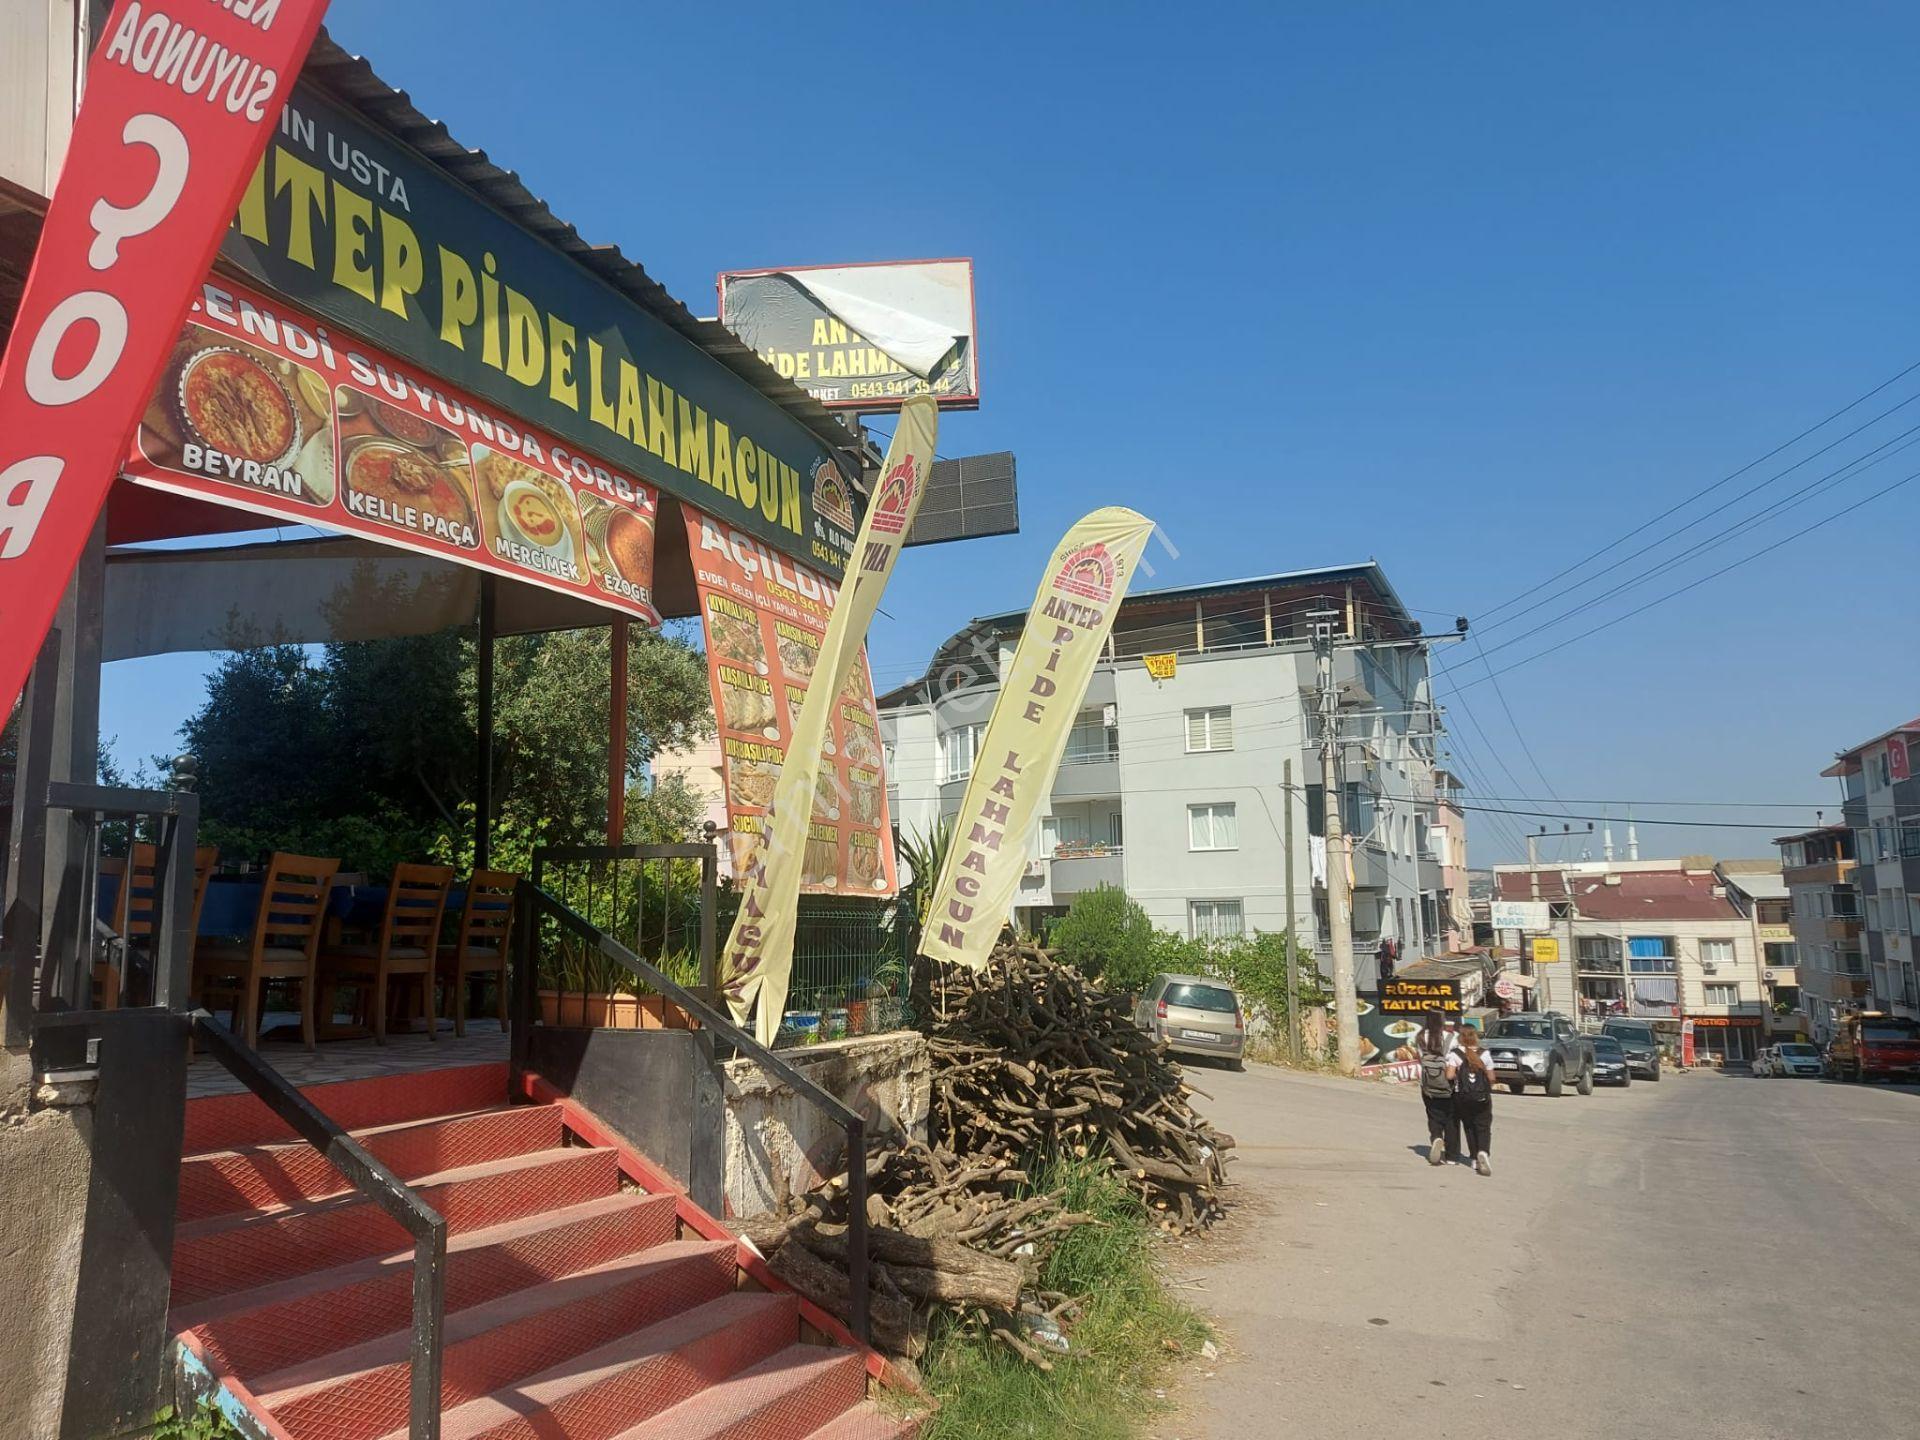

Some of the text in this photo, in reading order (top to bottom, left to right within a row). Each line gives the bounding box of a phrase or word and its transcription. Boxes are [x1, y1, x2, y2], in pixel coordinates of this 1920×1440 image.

[327, 131, 411, 212] USTA
[192, 283, 655, 513] ENDİ SUYUNDA ÇORBA
[439, 243, 580, 410] PİDE
[588, 336, 803, 536] LAHMACUN
[851, 382, 885, 398] 0543
[887, 382, 910, 395] 941
[915, 381, 931, 394] 35
[934, 378, 950, 393] 44
[181, 444, 303, 497] BEYRAN
[348, 489, 477, 547] KELLE PAÇA
[494, 536, 583, 583] MERCİMEK
[765, 581, 798, 604] 0543
[799, 597, 821, 615] 941
[1041, 596, 1104, 631] ANTEP
[1022, 624, 1075, 725] PİDE
[938, 750, 1022, 951] LAHMACUN
[1385, 982, 1453, 996] RÜZGAR
